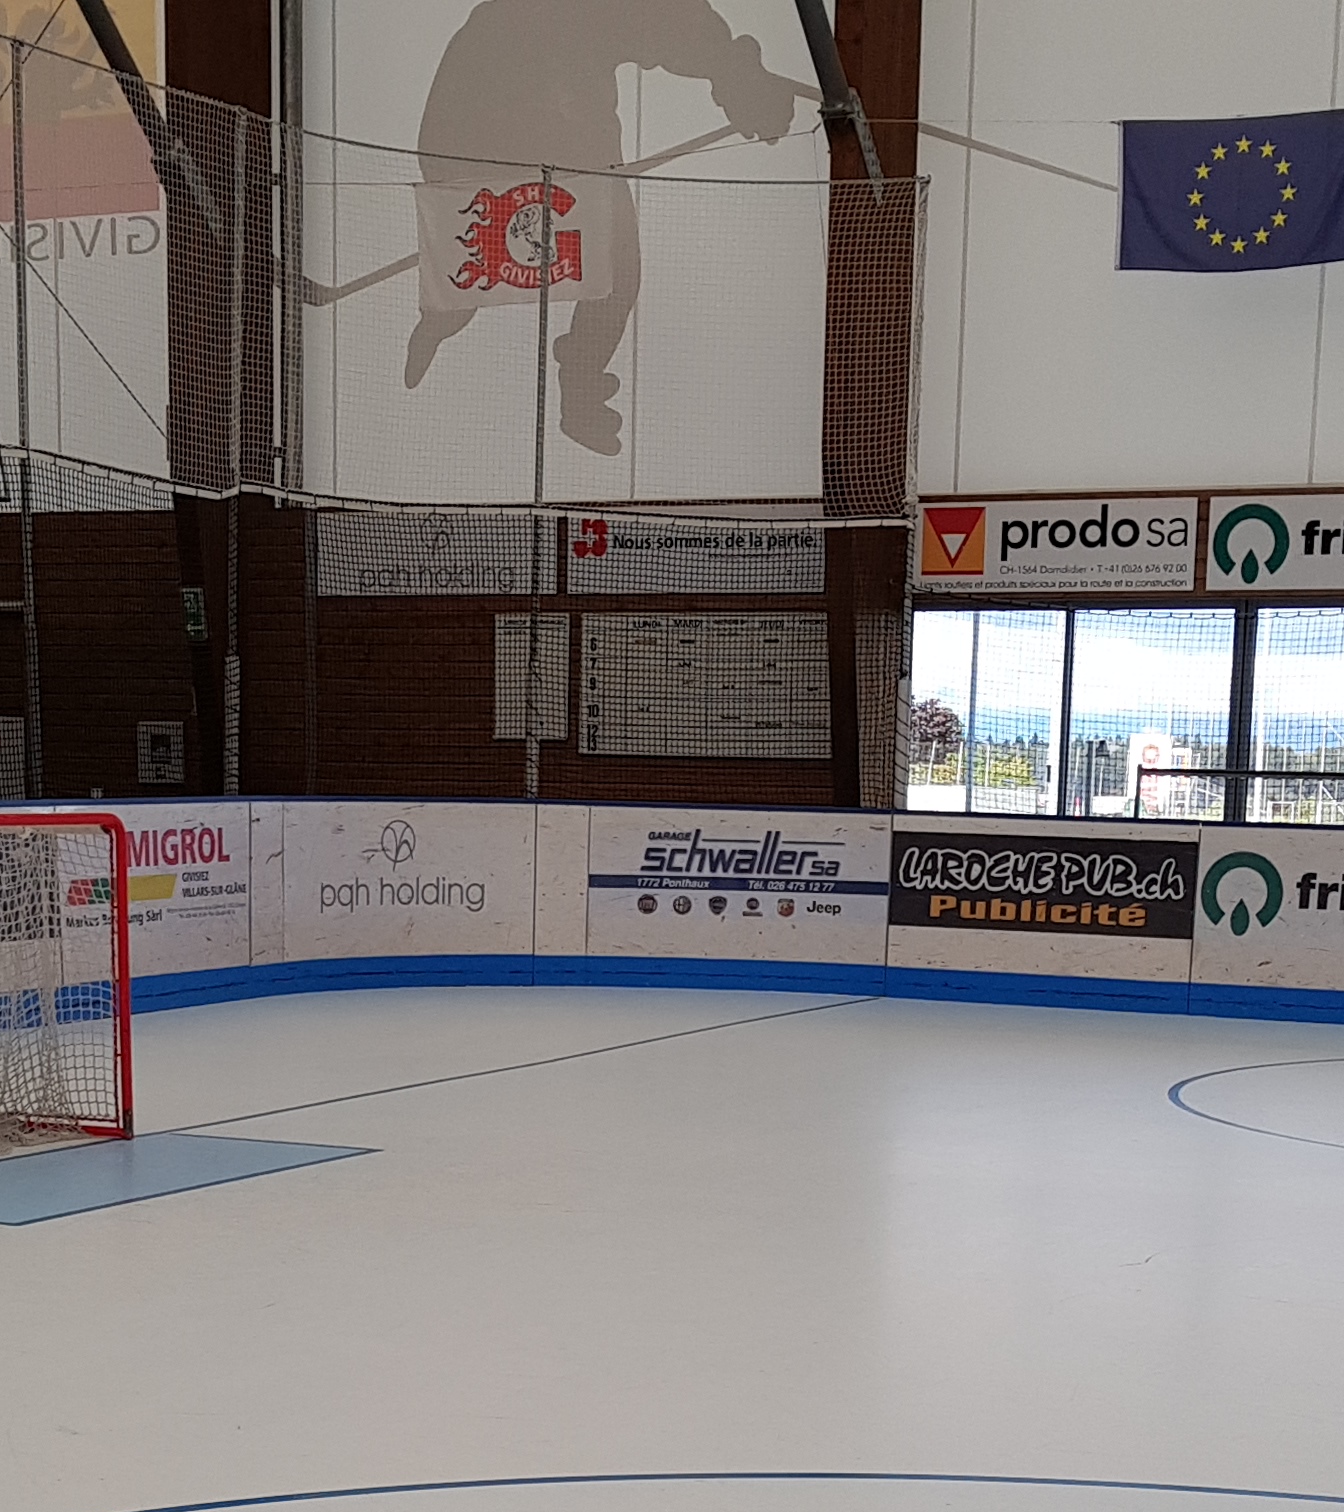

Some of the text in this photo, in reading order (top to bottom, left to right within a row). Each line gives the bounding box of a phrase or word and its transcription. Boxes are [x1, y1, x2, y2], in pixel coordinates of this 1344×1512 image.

[613, 534, 652, 550] Nous
[656, 535, 720, 549] sommes
[725, 531, 744, 548] de
[749, 531, 763, 547] la
[1000, 503, 1188, 562] prodo sa
[1135, 579, 1188, 588] construction
[126, 827, 230, 868] MIGROL
[647, 831, 692, 841] GARAGE
[640, 828, 841, 877] schwaller sa
[379, 876, 485, 912] holding
[662, 878, 710, 890] Ponthaux
[806, 900, 841, 916] Jeep
[929, 895, 1147, 927] Publicité
